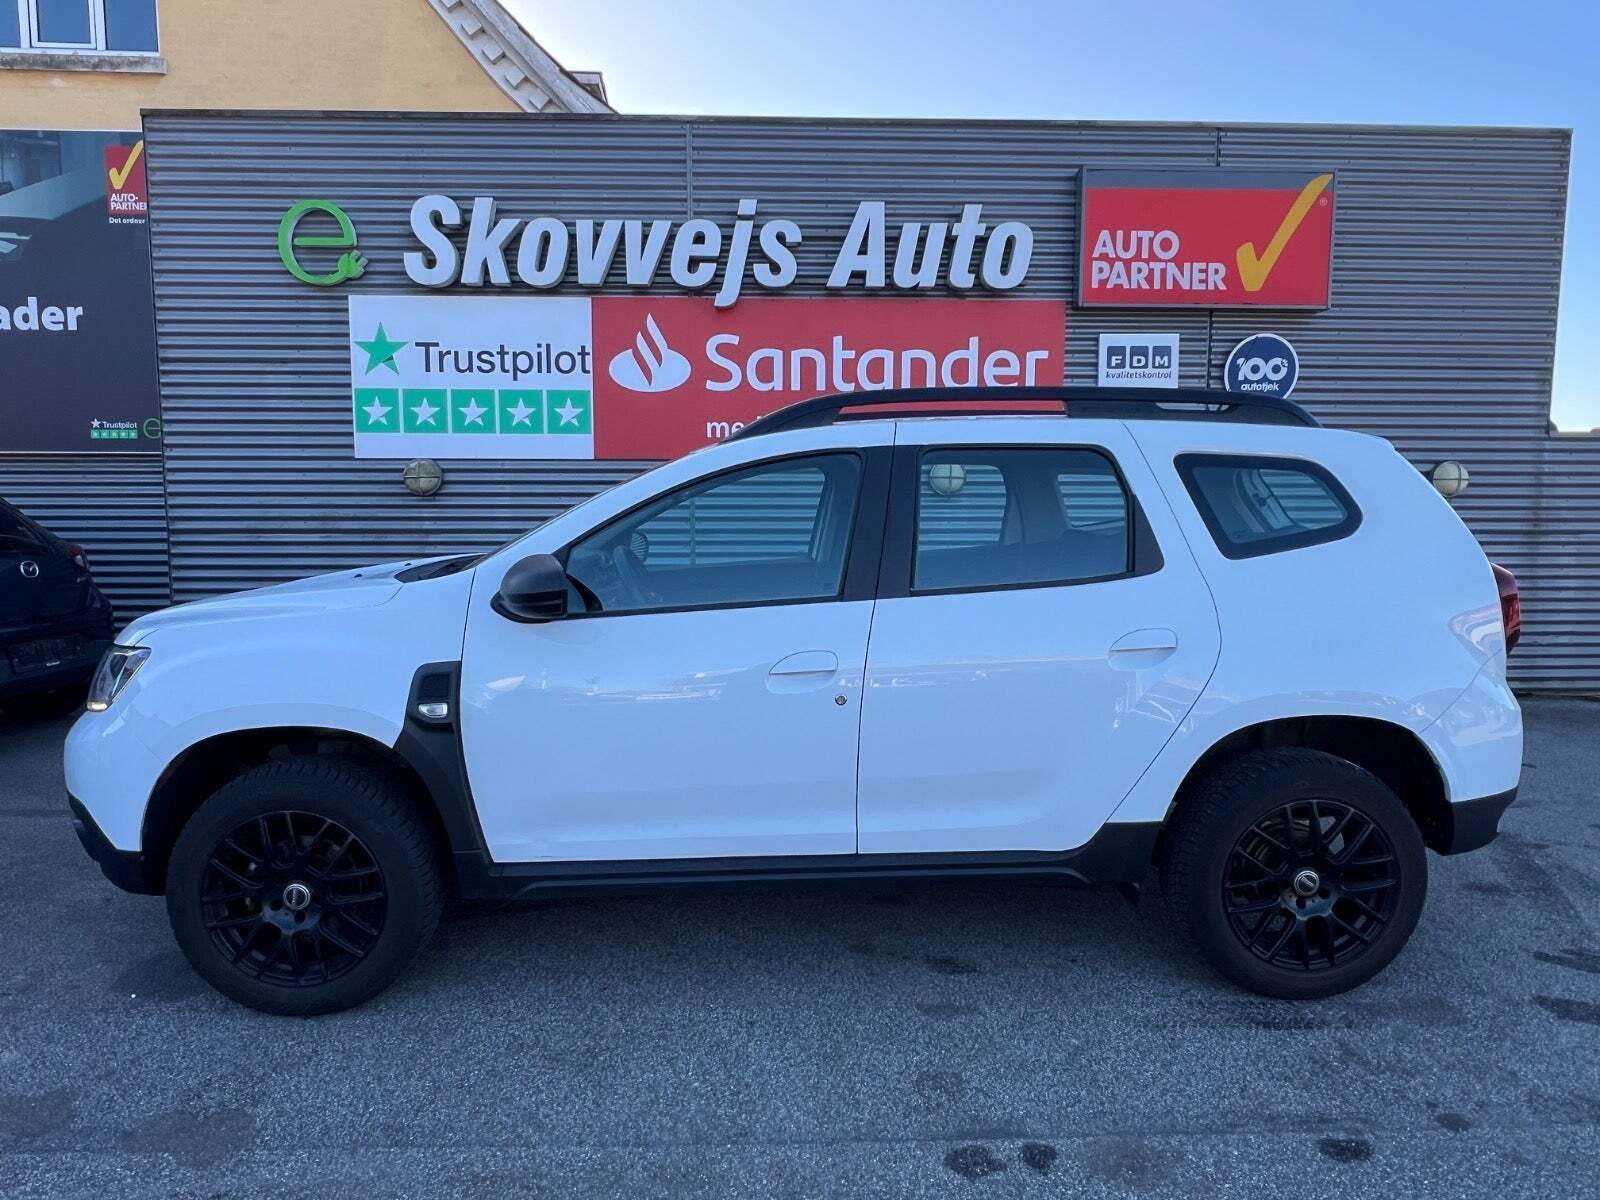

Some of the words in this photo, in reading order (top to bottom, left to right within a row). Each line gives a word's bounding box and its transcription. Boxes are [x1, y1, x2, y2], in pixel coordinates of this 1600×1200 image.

[403, 194, 803, 307] Skovvejs
[826, 200, 1034, 290] Auto
[1092, 229, 1180, 260] AUTO
[1091, 260, 1228, 290] PARTNER
[415, 341, 591, 381] Trustpilot
[705, 333, 1050, 392] Santander
[1106, 370, 1172, 379] kvalitetskontrol
[1241, 382, 1280, 392] autotjek
[101, 421, 137, 430] Trustpilot
